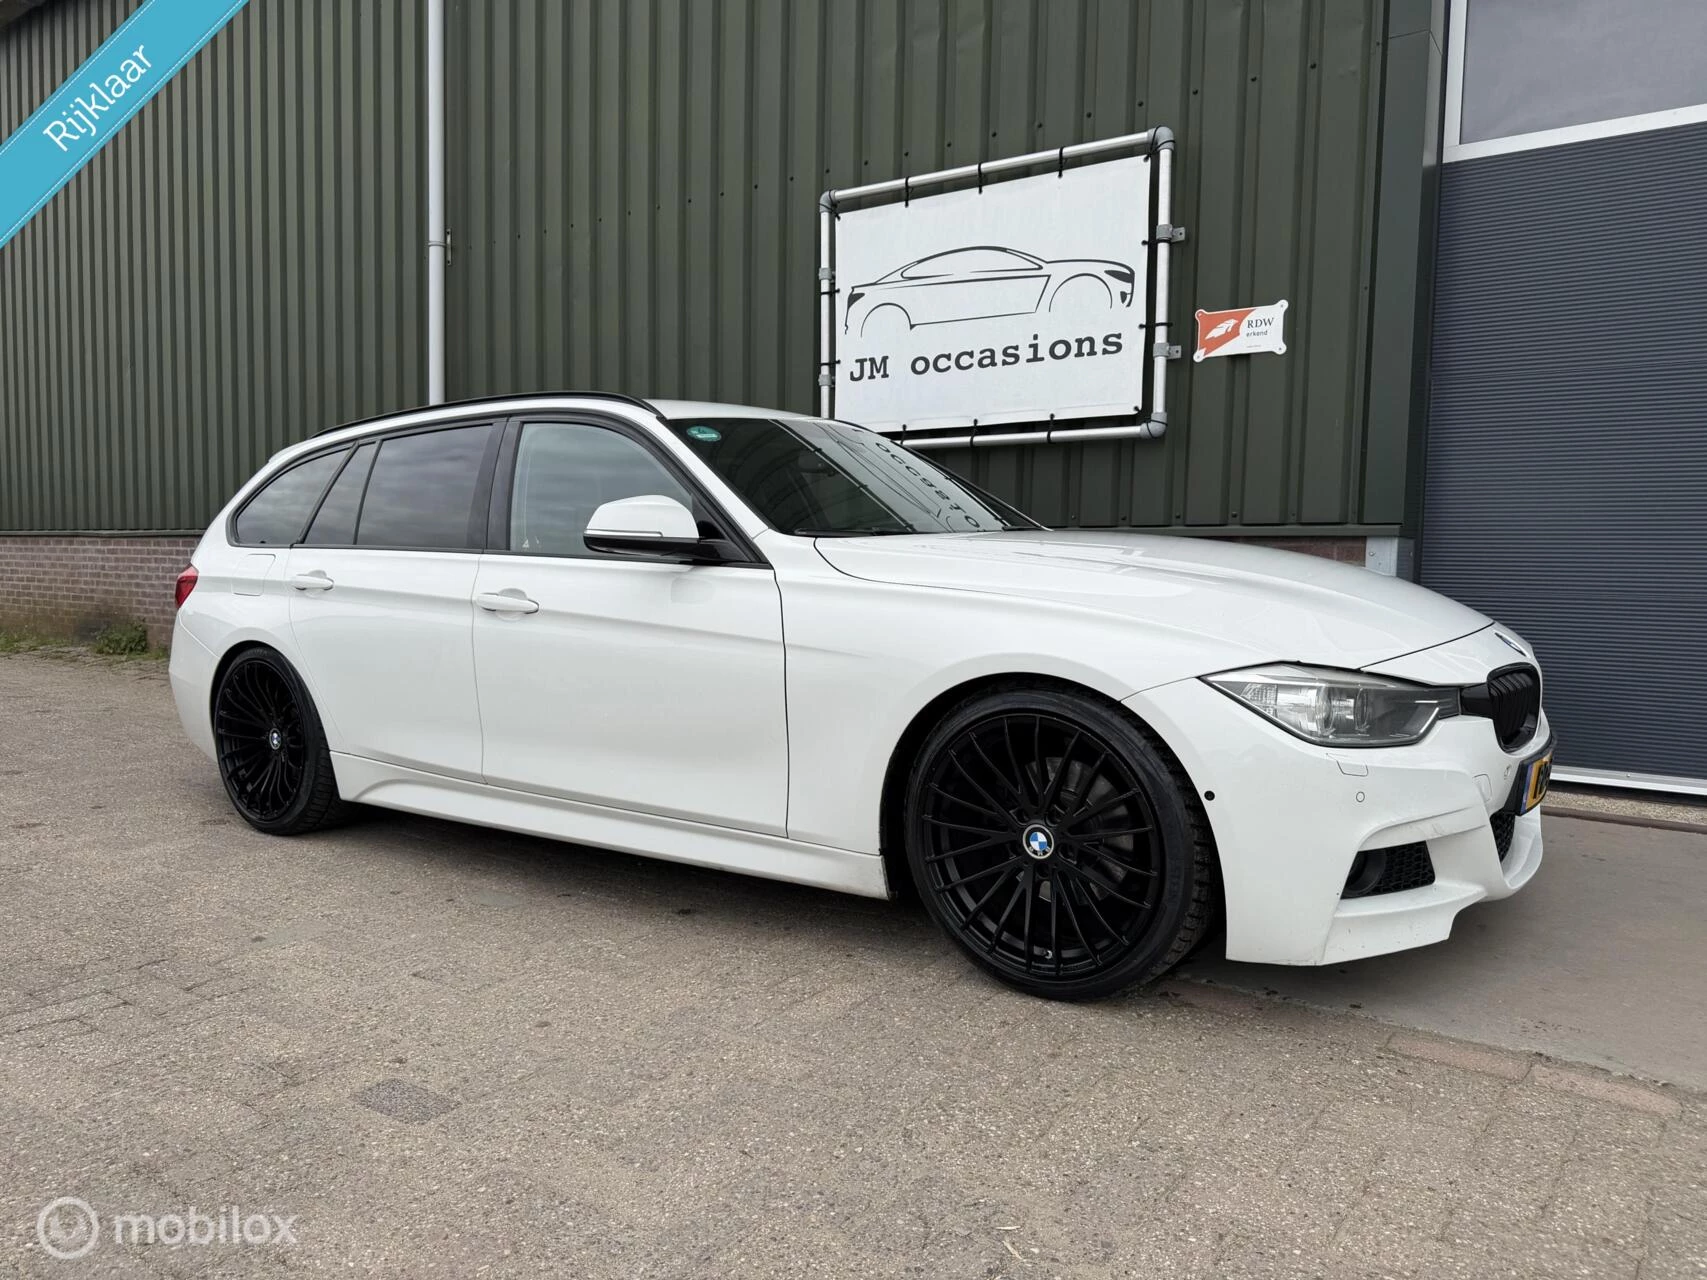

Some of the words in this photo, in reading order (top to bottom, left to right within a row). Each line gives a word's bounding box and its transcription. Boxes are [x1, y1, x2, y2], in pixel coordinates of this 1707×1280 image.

[1247, 317, 1274, 329] RDW
[1246, 329, 1268, 338] erkend
[850, 355, 889, 382] JM
[910, 332, 1123, 375] occasions
